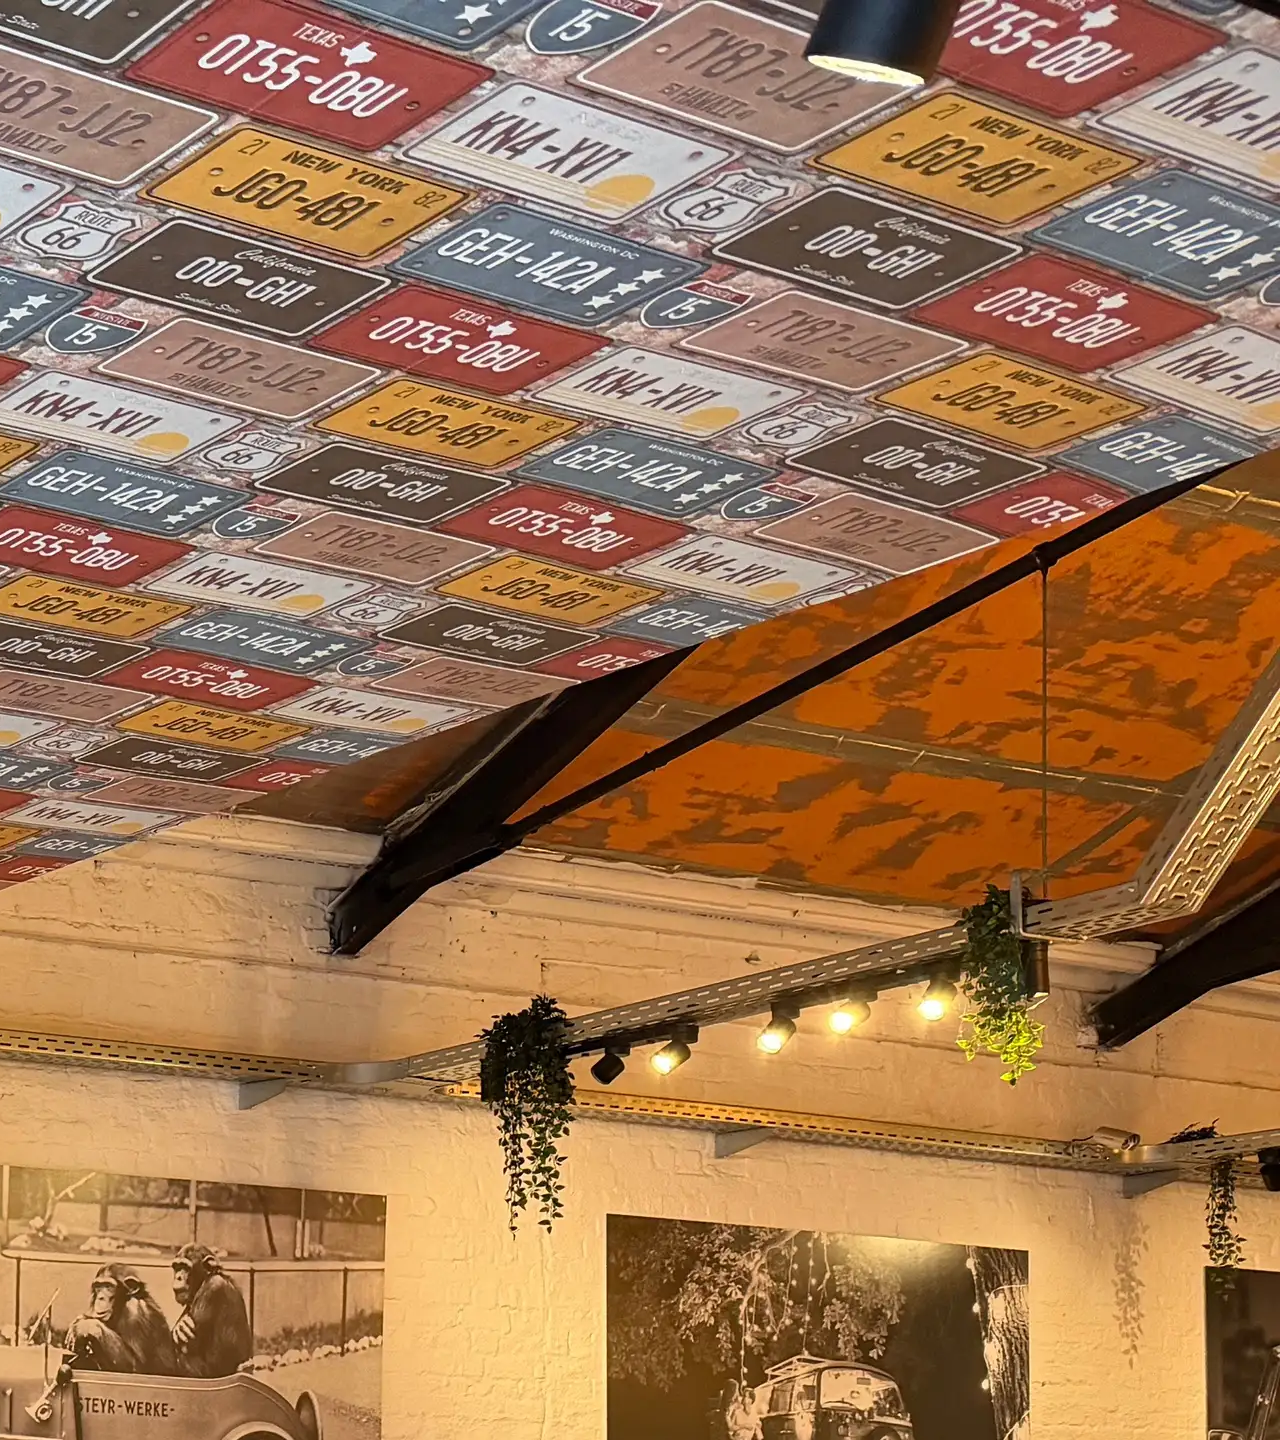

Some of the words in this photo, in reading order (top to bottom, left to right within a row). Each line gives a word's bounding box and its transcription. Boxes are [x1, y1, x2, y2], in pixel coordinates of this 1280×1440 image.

[290, 23, 348, 48] TEXAS
[962, 115, 1033, 140] NEW
[1019, 132, 1096, 159] YORK
[278, 150, 346, 174] NEW
[340, 168, 415, 194] YORK
[682, 198, 738, 220] 66
[1085, 193, 1257, 278] GEH-142A
[435, 226, 620, 294] GEH-142A
[656, 296, 716, 320] 15
[178, 619, 314, 655] GEH-142A
[348, 659, 388, 671] 15
